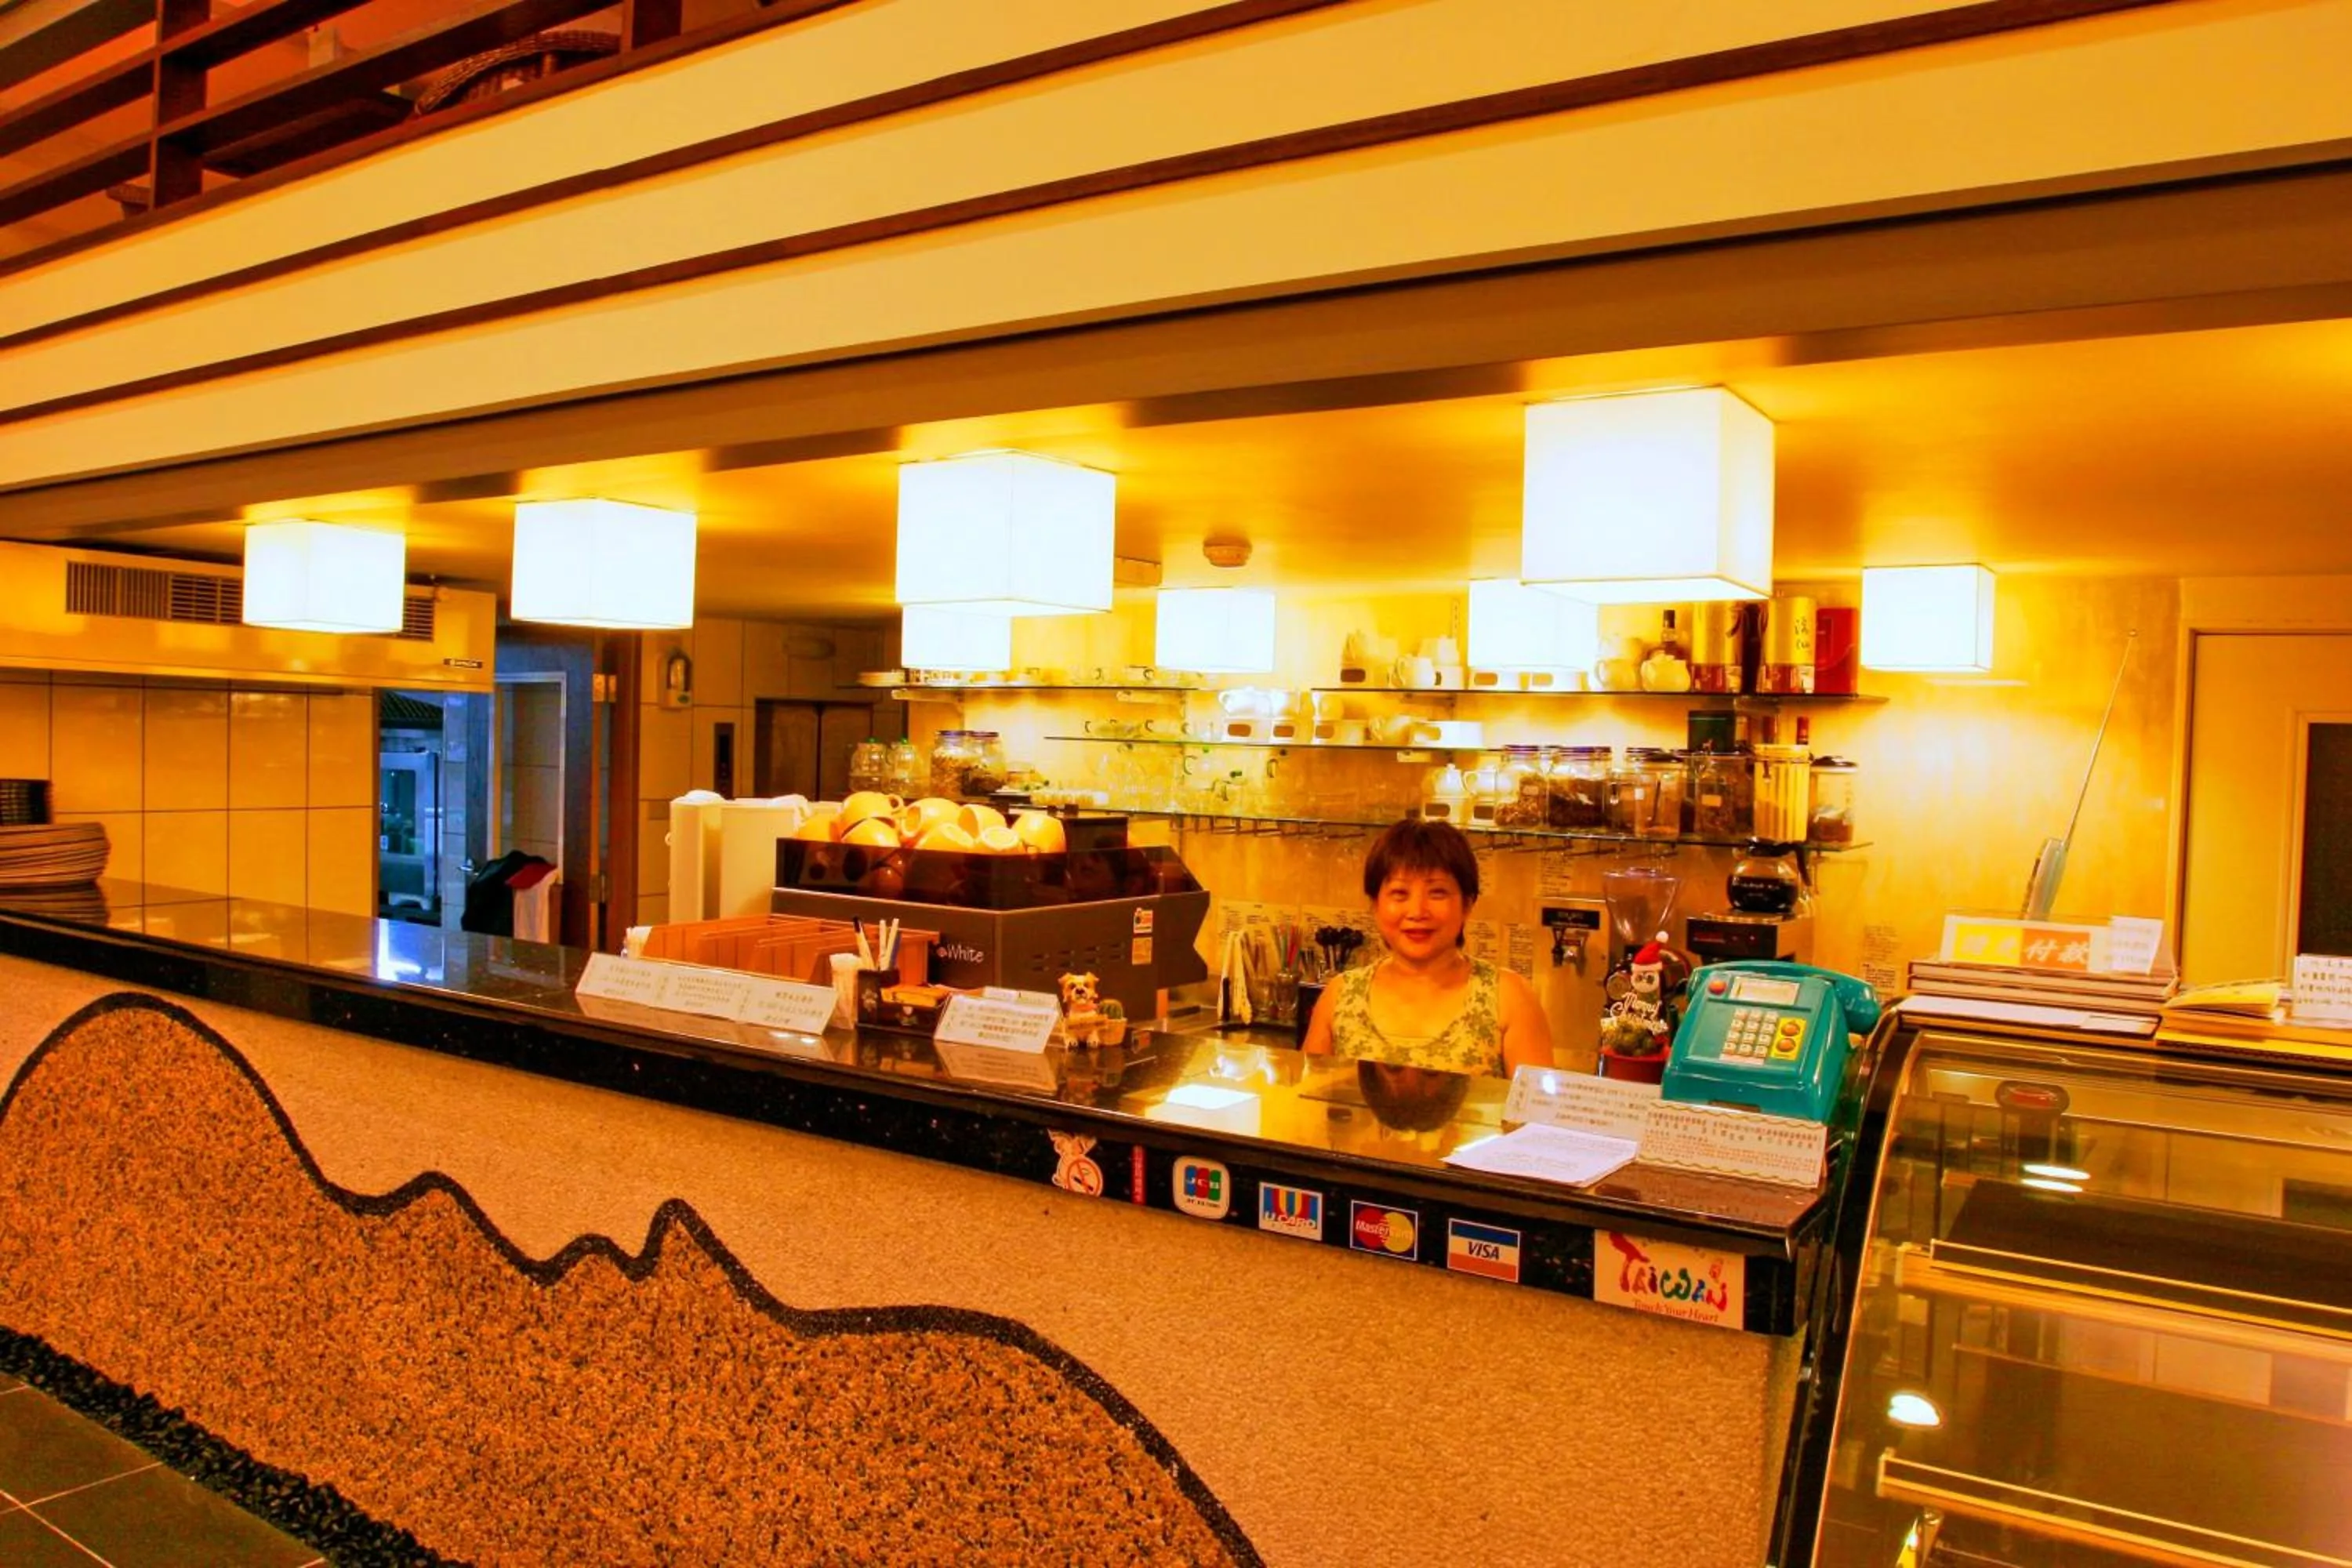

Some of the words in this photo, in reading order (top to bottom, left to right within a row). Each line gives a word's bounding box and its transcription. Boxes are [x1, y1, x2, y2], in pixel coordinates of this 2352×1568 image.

[1185, 1177, 1220, 1189] JCB
[1356, 1220, 1414, 1239] MasterCard
[1467, 1241, 1501, 1261] VISA
[1687, 1307, 1719, 1323] Heart
